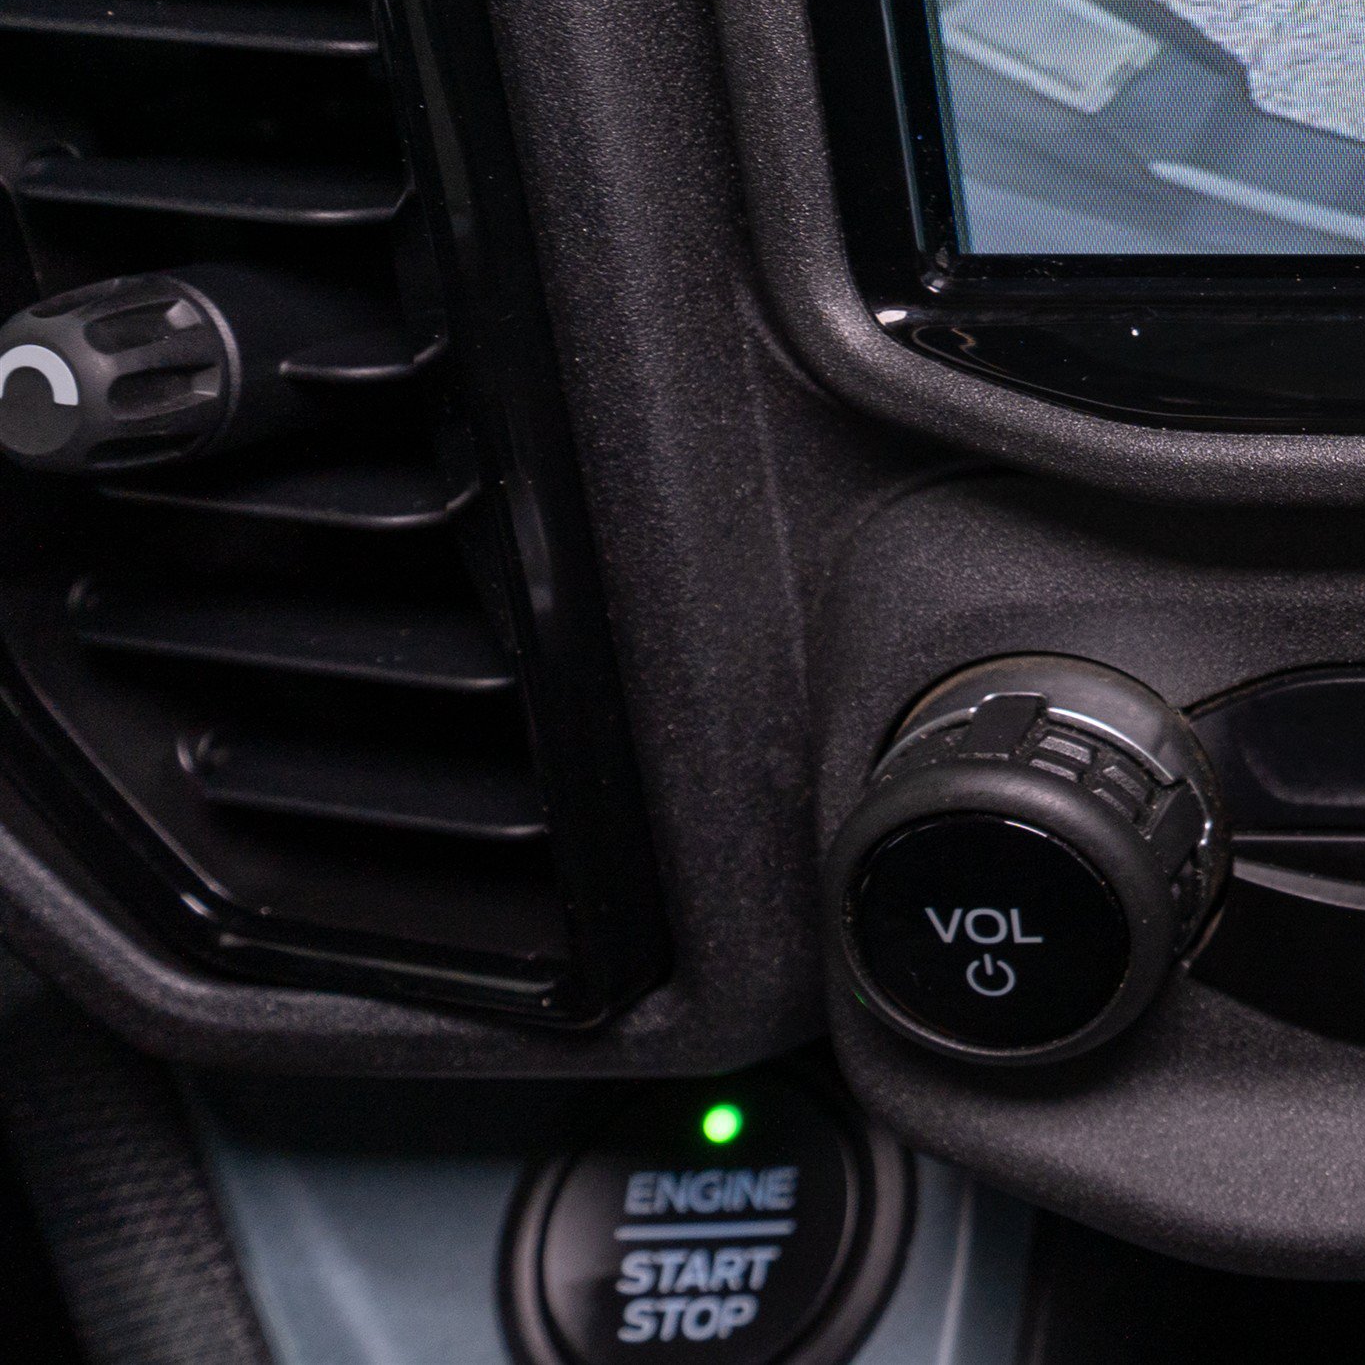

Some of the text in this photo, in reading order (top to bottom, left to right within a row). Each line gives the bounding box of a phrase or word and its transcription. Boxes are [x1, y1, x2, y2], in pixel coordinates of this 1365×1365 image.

[924, 906, 1044, 945] VOL
[624, 1166, 799, 1215] ENGINE
[614, 1244, 782, 1295] START
[616, 1294, 759, 1343] STOP
